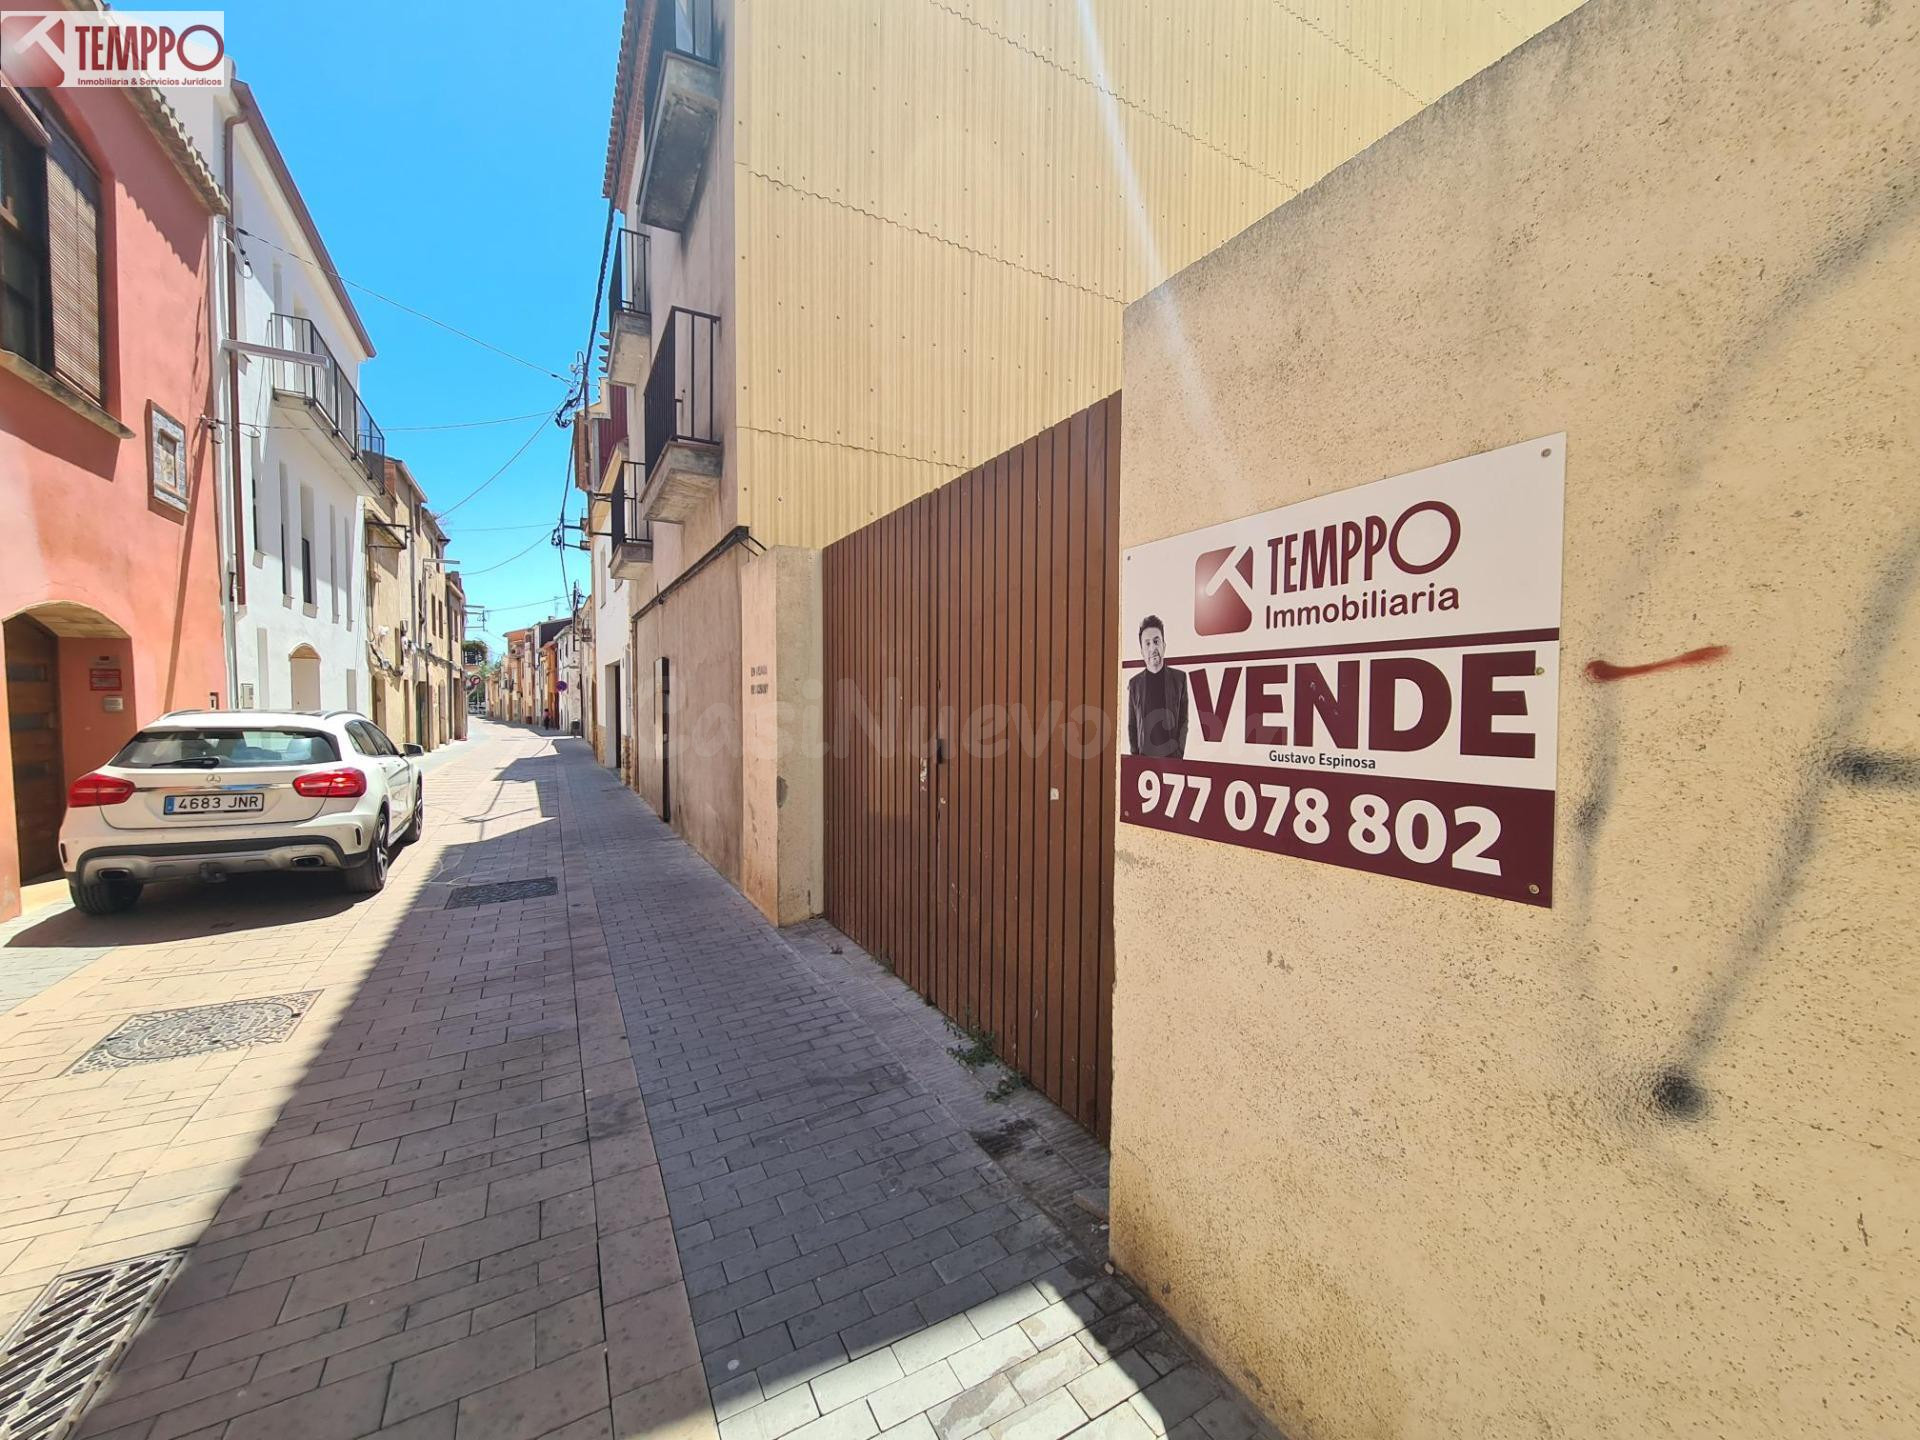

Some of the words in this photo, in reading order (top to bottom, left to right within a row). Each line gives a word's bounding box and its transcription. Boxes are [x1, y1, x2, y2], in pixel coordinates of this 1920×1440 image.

[1267, 500, 1461, 595] TEMPPO
[1265, 582, 1460, 630] Immobiliaria
[1188, 650, 1536, 759] VENDE
[1269, 750, 1316, 766] Gustavo
[1318, 752, 1376, 770] Espinosa
[178, 797, 221, 810] 4683
[228, 796, 259, 808] JNR
[1137, 770, 1212, 823] 977
[1223, 780, 1331, 845] 078
[1347, 794, 1502, 877] 802
